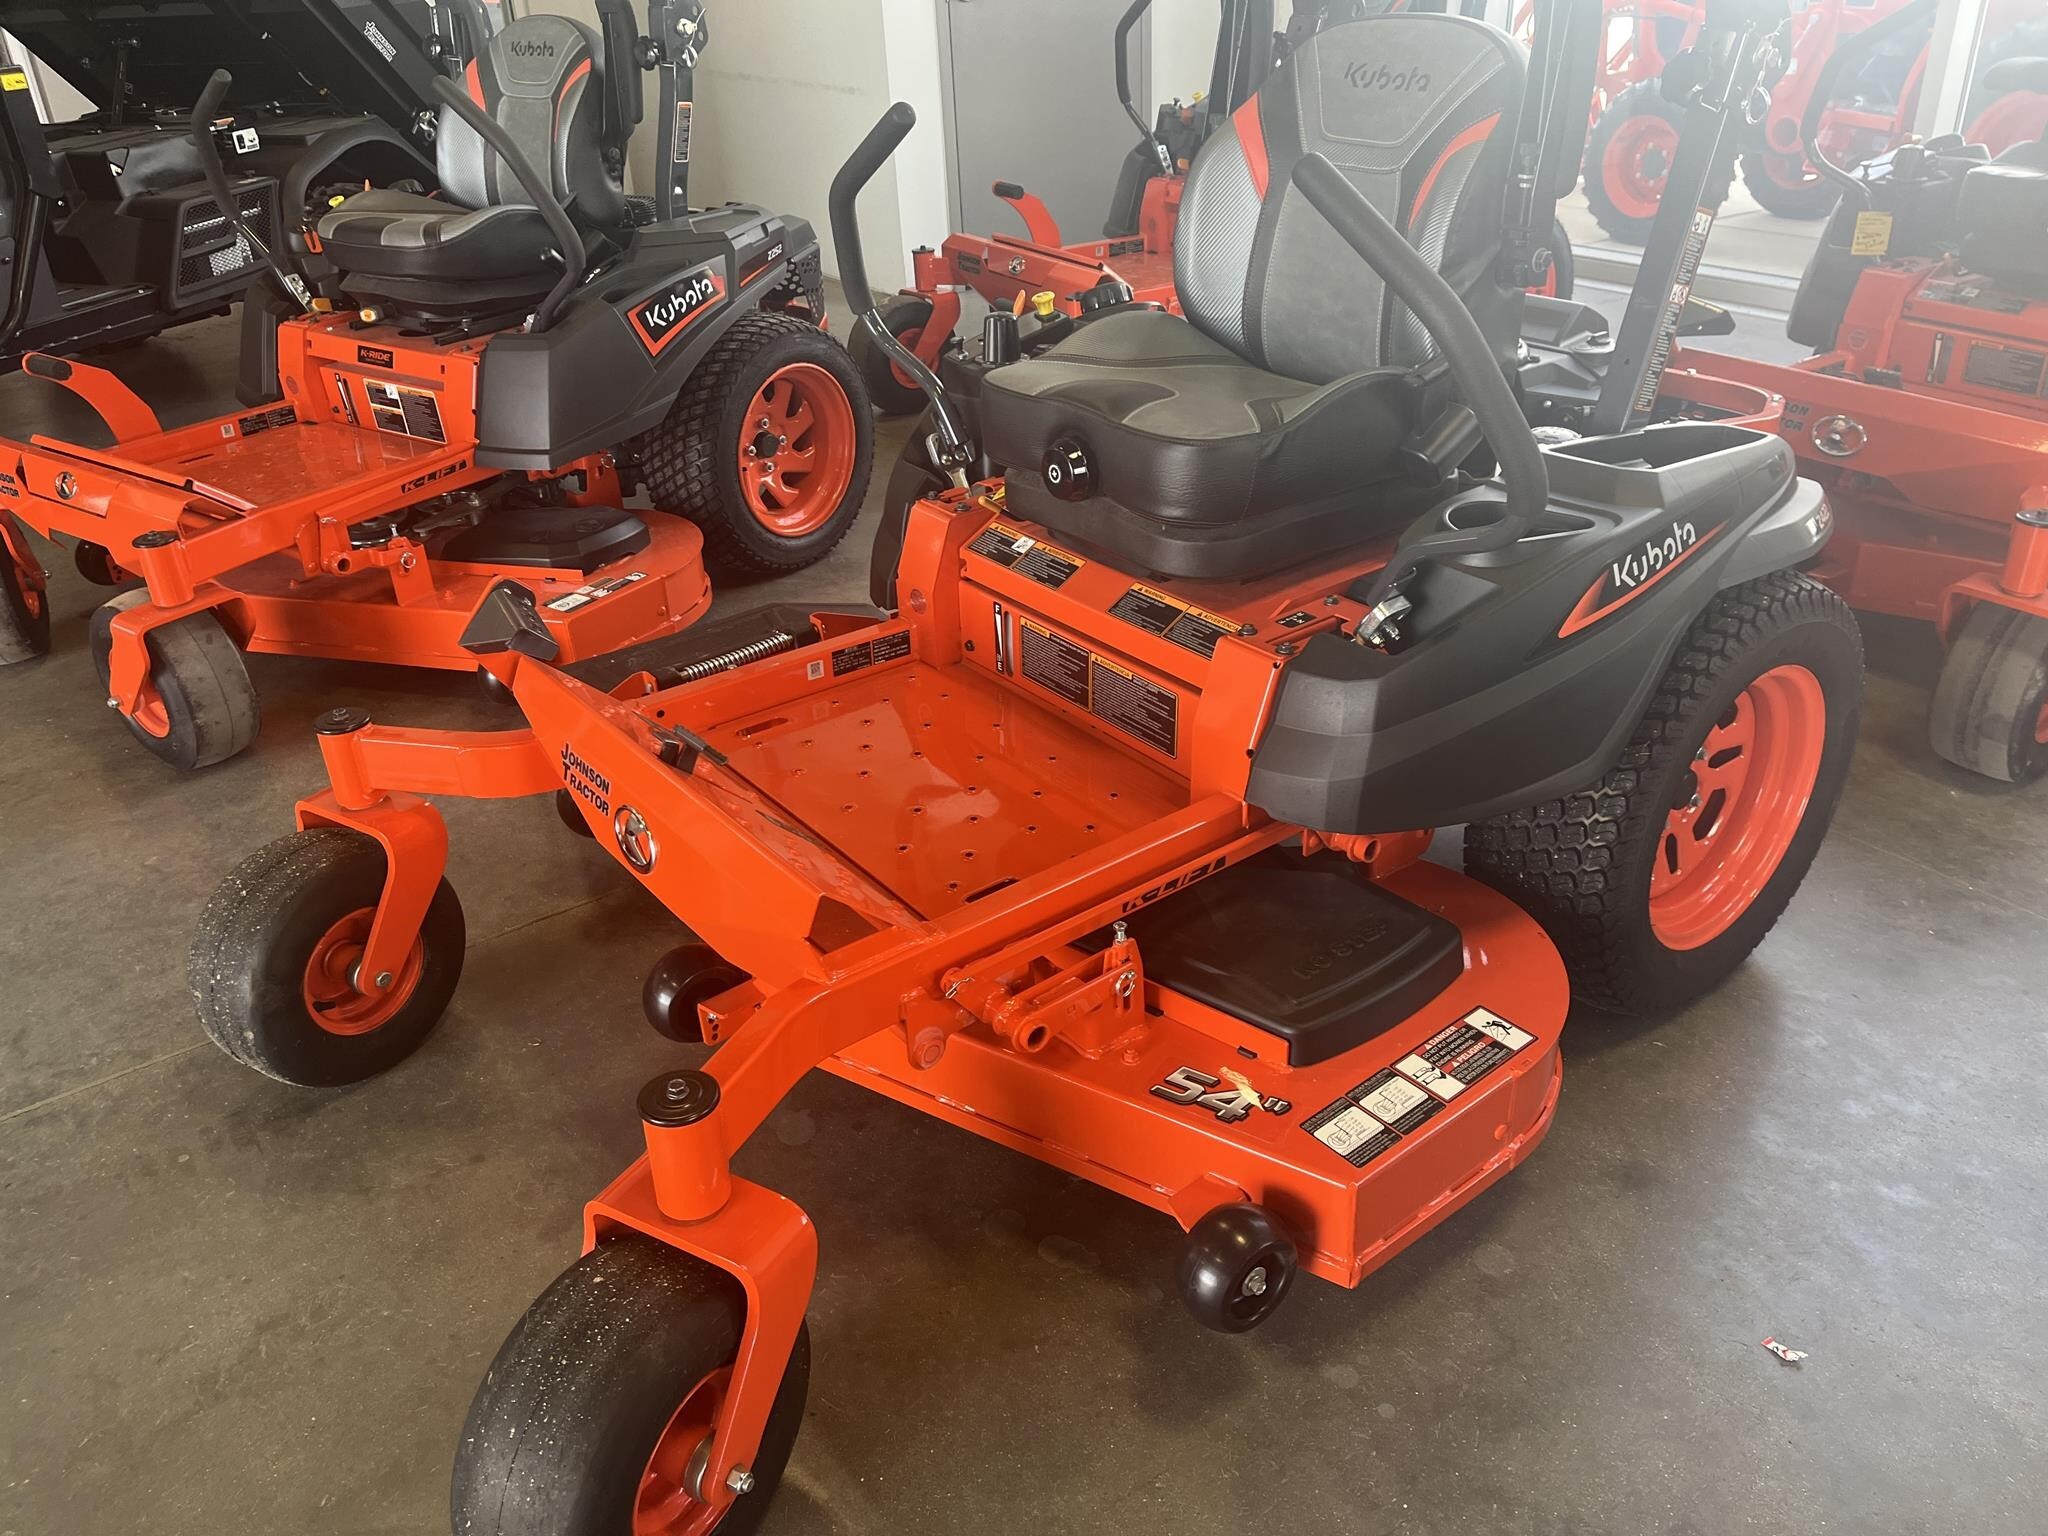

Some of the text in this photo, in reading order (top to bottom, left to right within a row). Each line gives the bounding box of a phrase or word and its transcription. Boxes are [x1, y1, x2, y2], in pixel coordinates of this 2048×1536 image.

[511, 41, 554, 57] Kubota
[1344, 62, 1431, 92] Kubota
[645, 278, 714, 328] Kubota
[360, 348, 391, 361] K-RIDE
[1612, 521, 1697, 588] Kubota
[1143, 588, 1167, 601] WARNING
[995, 604, 1001, 613] F
[997, 661, 1003, 671] E
[561, 743, 610, 795] JOHNSON
[562, 761, 609, 816] TRACTOR
[1124, 855, 1227, 912] K-LIFT
[1428, 1024, 1458, 1046] DANGER
[1455, 1041, 1487, 1062] PELIGRO
